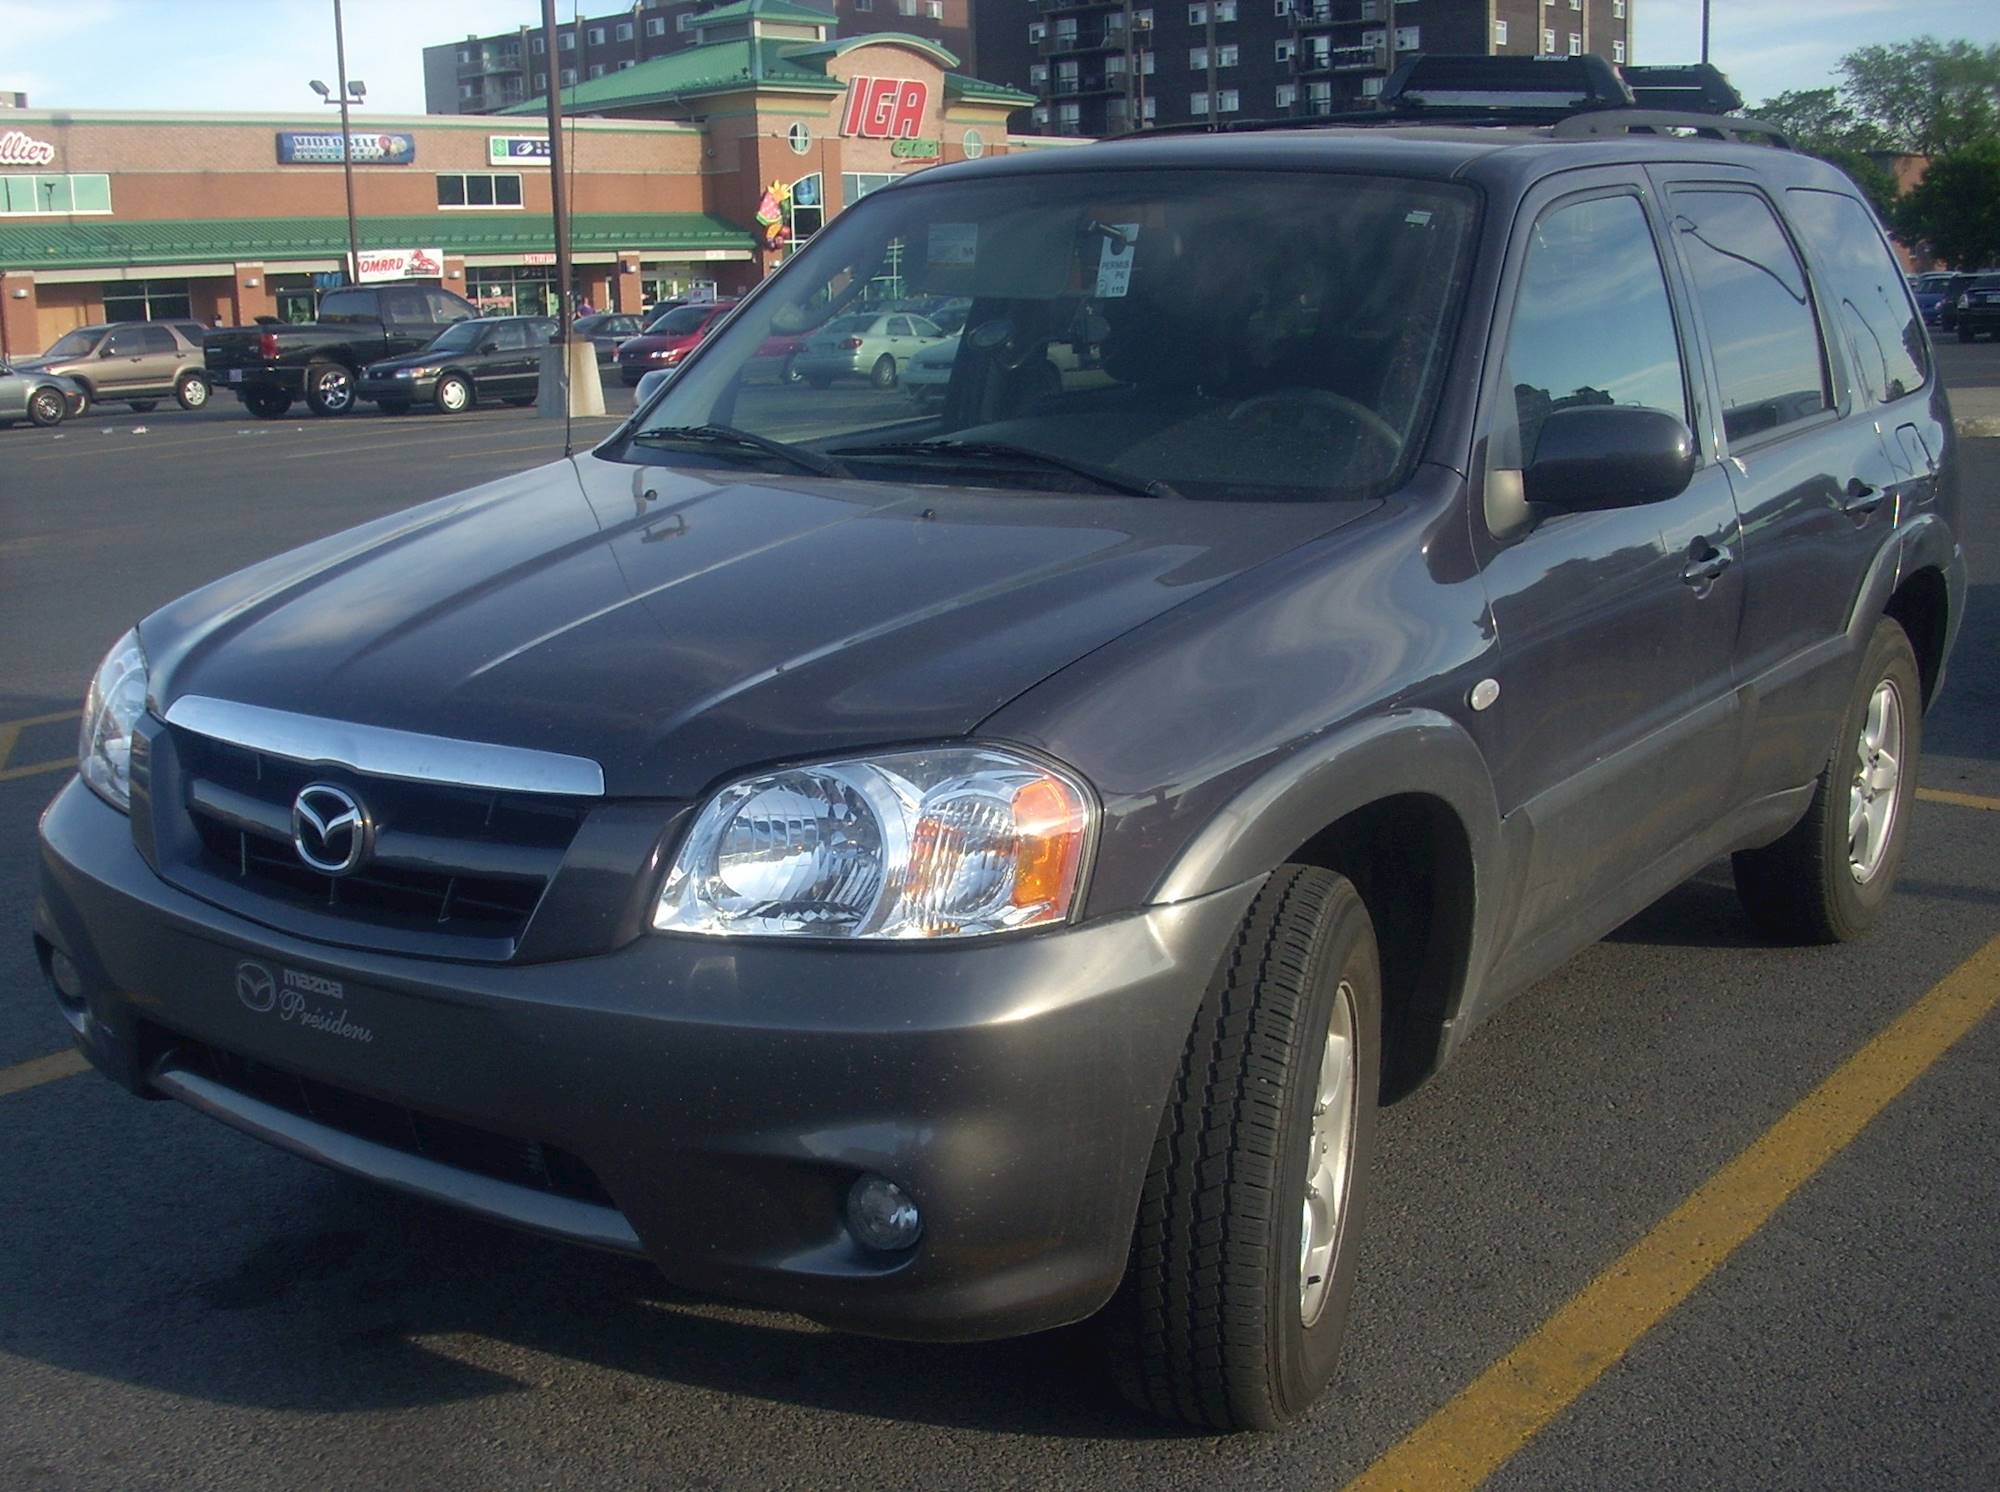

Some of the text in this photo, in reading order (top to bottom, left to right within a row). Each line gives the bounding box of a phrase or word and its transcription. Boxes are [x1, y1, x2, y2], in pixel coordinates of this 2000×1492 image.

[843, 75, 929, 138] IGA
[0, 133, 53, 162] llier
[294, 137, 343, 147] VIDEO
